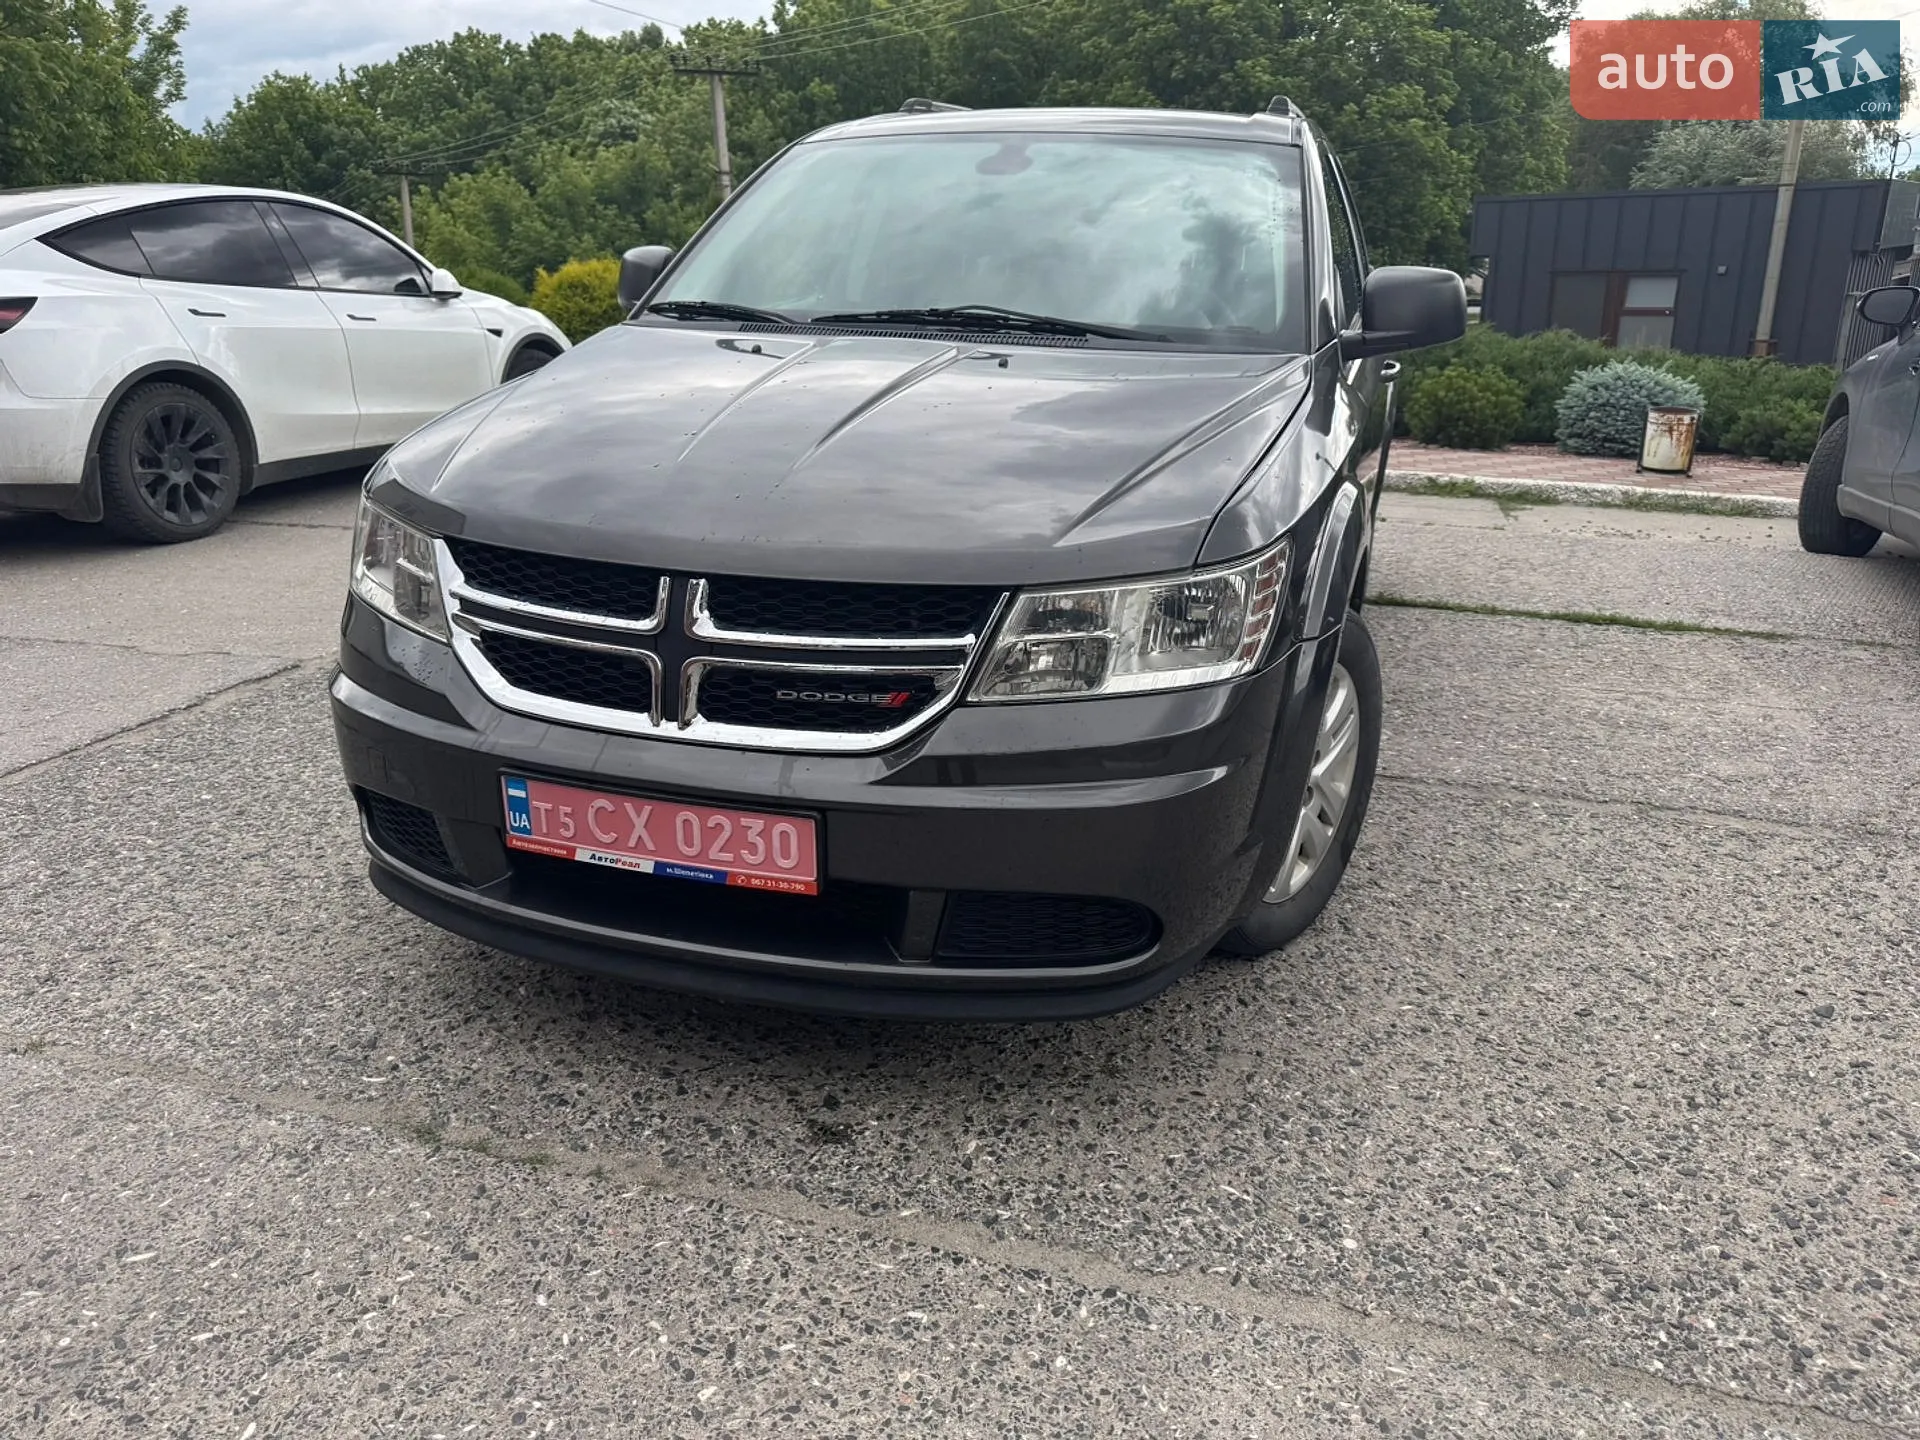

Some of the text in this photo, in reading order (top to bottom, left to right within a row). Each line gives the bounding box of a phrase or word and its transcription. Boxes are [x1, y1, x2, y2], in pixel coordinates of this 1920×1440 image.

[776, 690, 894, 703] DODGE
[509, 811, 531, 829] UA
[532, 798, 799, 870] T5 CX 0230
